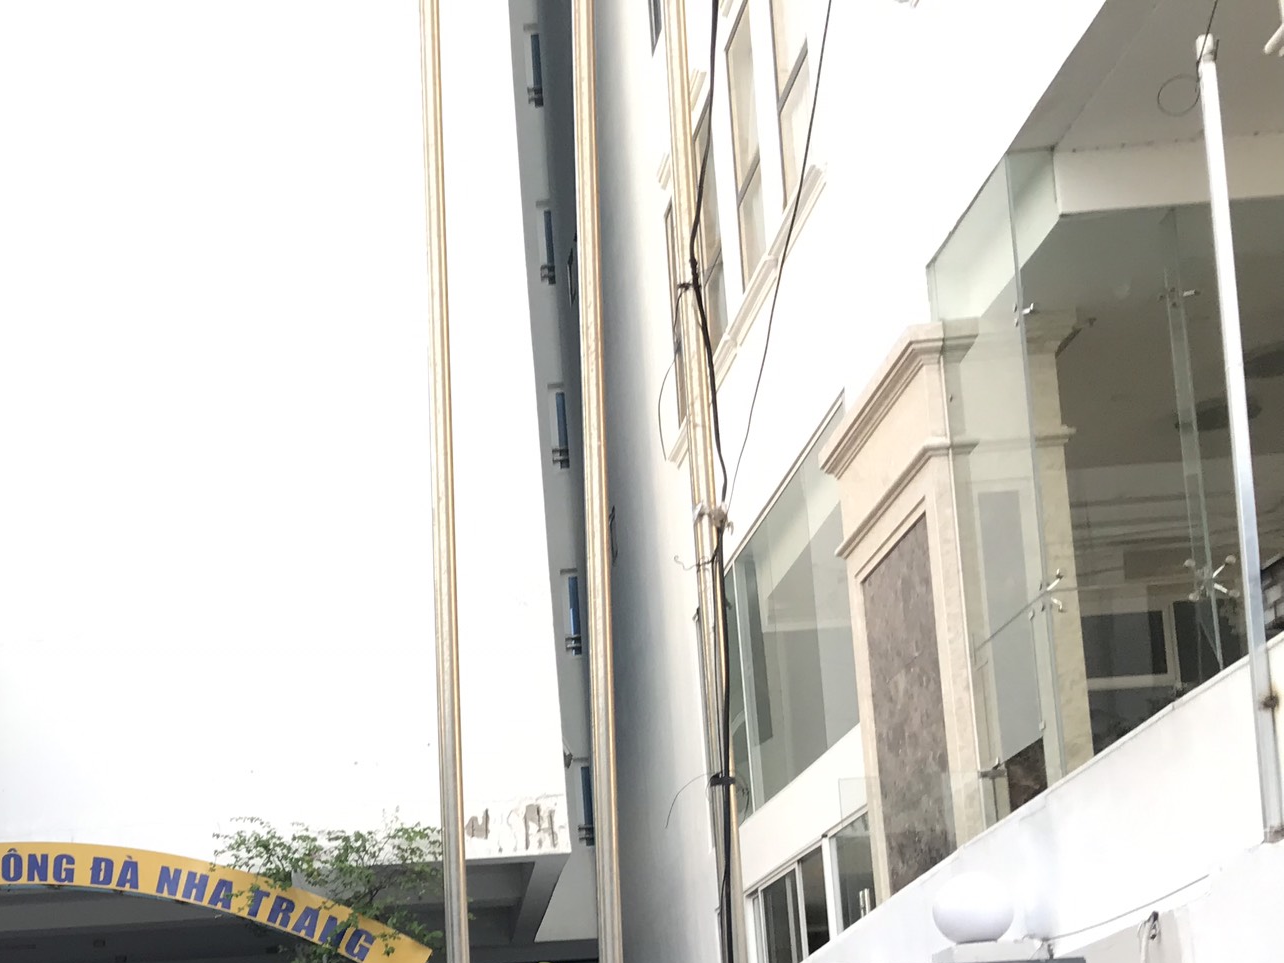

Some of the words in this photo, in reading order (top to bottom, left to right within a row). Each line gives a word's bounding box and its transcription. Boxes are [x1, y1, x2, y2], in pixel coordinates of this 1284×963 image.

[90, 855, 139, 890] ĐÀ
[156, 865, 234, 910] NHA
[246, 887, 376, 961] TRANG
